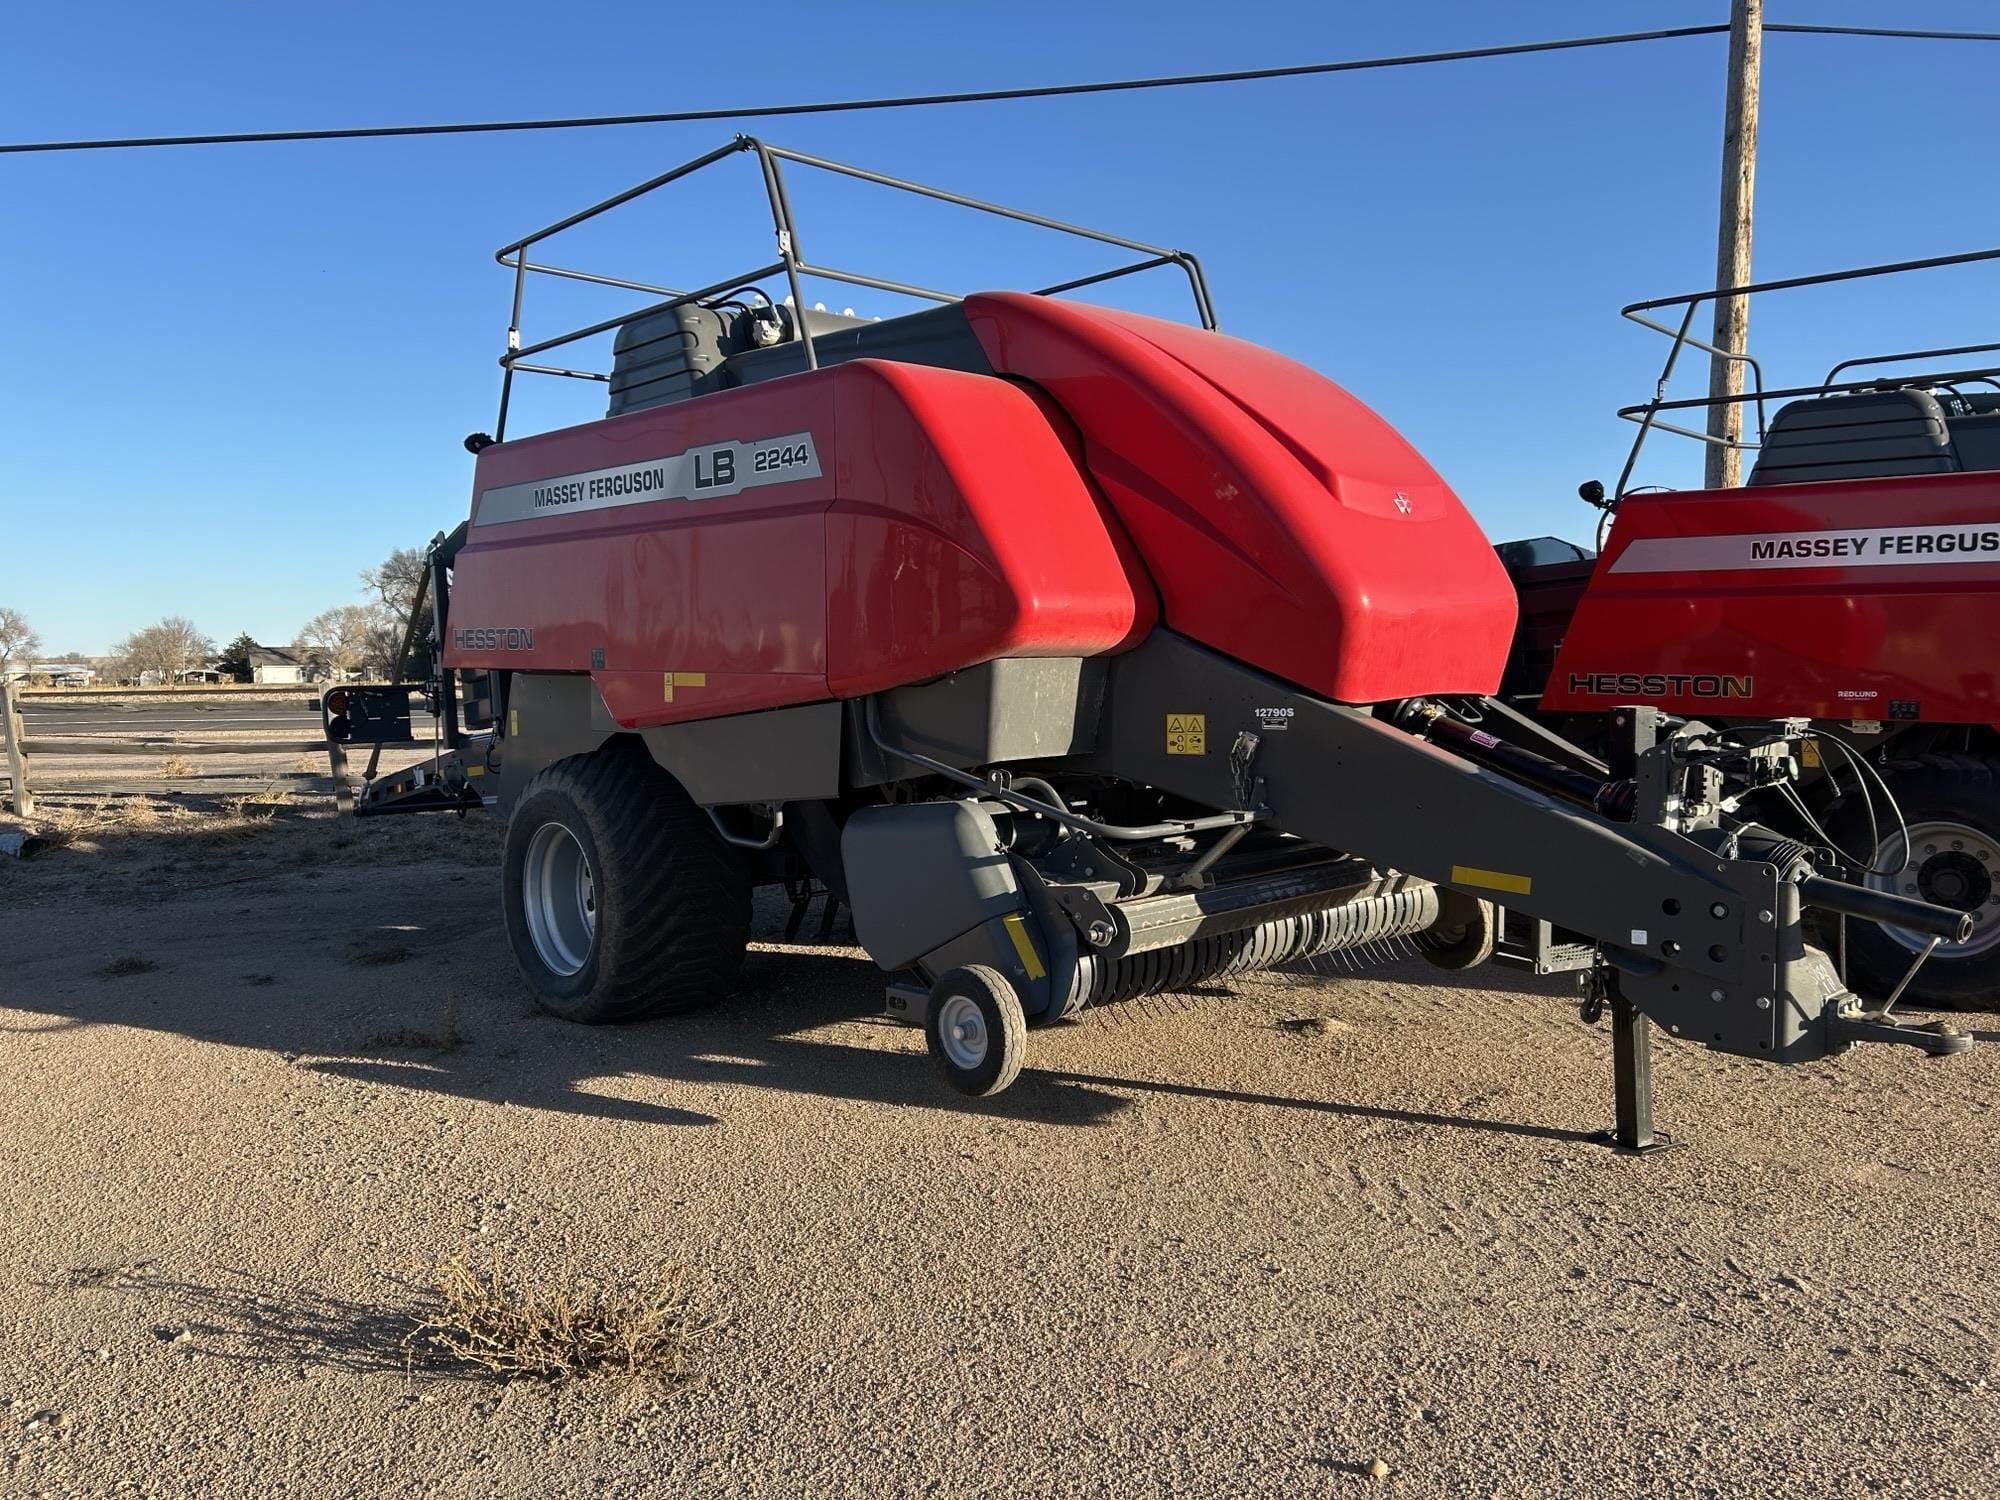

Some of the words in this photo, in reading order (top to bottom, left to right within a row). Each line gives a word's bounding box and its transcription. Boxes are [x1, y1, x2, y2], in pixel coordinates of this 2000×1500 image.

[534, 481, 585, 508] MASSEY
[589, 468, 664, 500] FERGUSON
[694, 448, 736, 490] LB
[754, 443, 809, 473] 2244
[1751, 537, 1869, 560] MASSEY
[454, 628, 534, 650] HESSTON
[1568, 673, 1752, 698] HESSTON
[1837, 690, 1879, 698] REDLUND
[1254, 707, 1295, 717] 12790S
